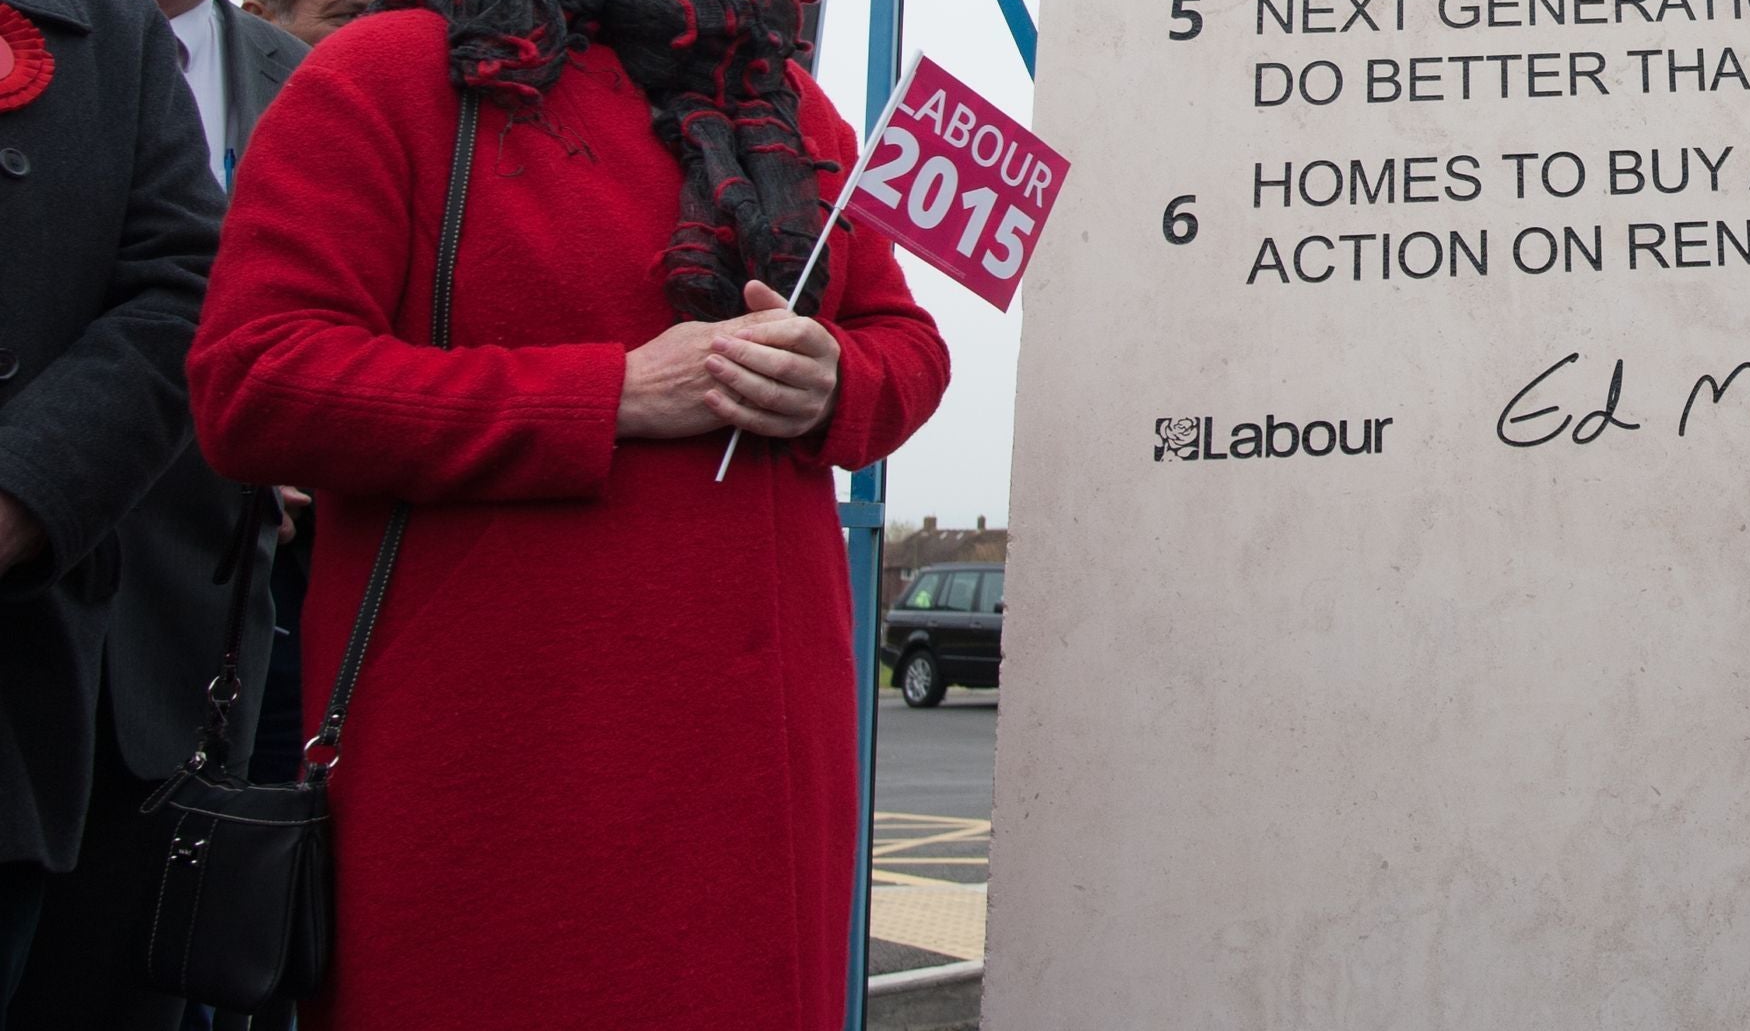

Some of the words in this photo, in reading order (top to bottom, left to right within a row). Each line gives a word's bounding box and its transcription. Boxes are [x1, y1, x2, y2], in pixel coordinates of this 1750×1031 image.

[1255, 61, 1343, 107] DO
[1367, 52, 1610, 103] BETTER
[898, 72, 1052, 208] LABOUR
[856, 126, 1035, 279] 2015
[1254, 155, 1481, 208] HOMES
[1502, 152, 1585, 198] TO
[1609, 146, 1733, 195] BUY
[1163, 195, 1198, 245] 6
[1246, 230, 1487, 284] ACTION
[1513, 225, 1602, 274] ON
[1497, 353, 1640, 447] Ed
[1203, 415, 1393, 460] Labour
